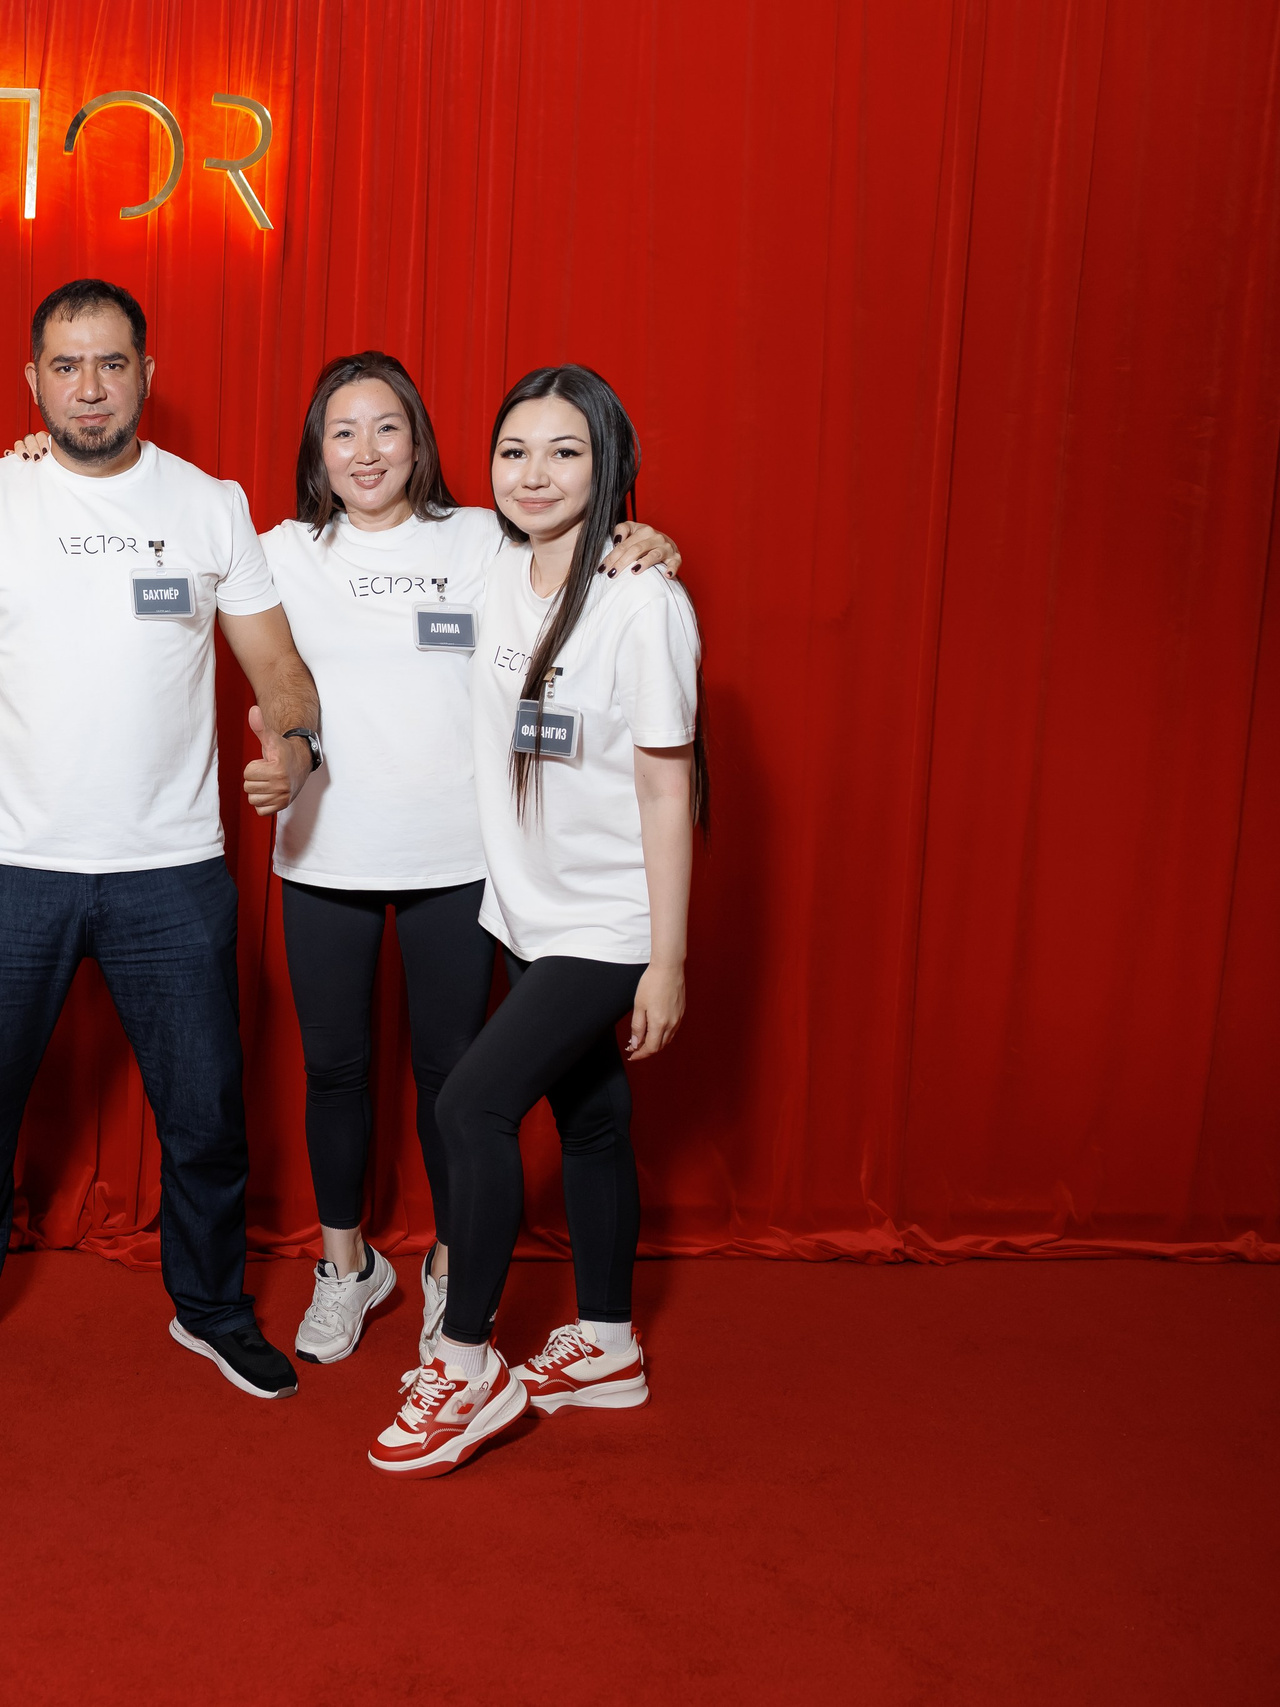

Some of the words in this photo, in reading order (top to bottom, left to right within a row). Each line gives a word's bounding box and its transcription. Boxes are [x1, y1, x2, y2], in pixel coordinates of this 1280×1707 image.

[59, 535, 139, 554] VECTOR
[142, 587, 180, 601] БАХТИЁР
[349, 577, 426, 597] VECTOR
[431, 623, 460, 634] АЛИМА
